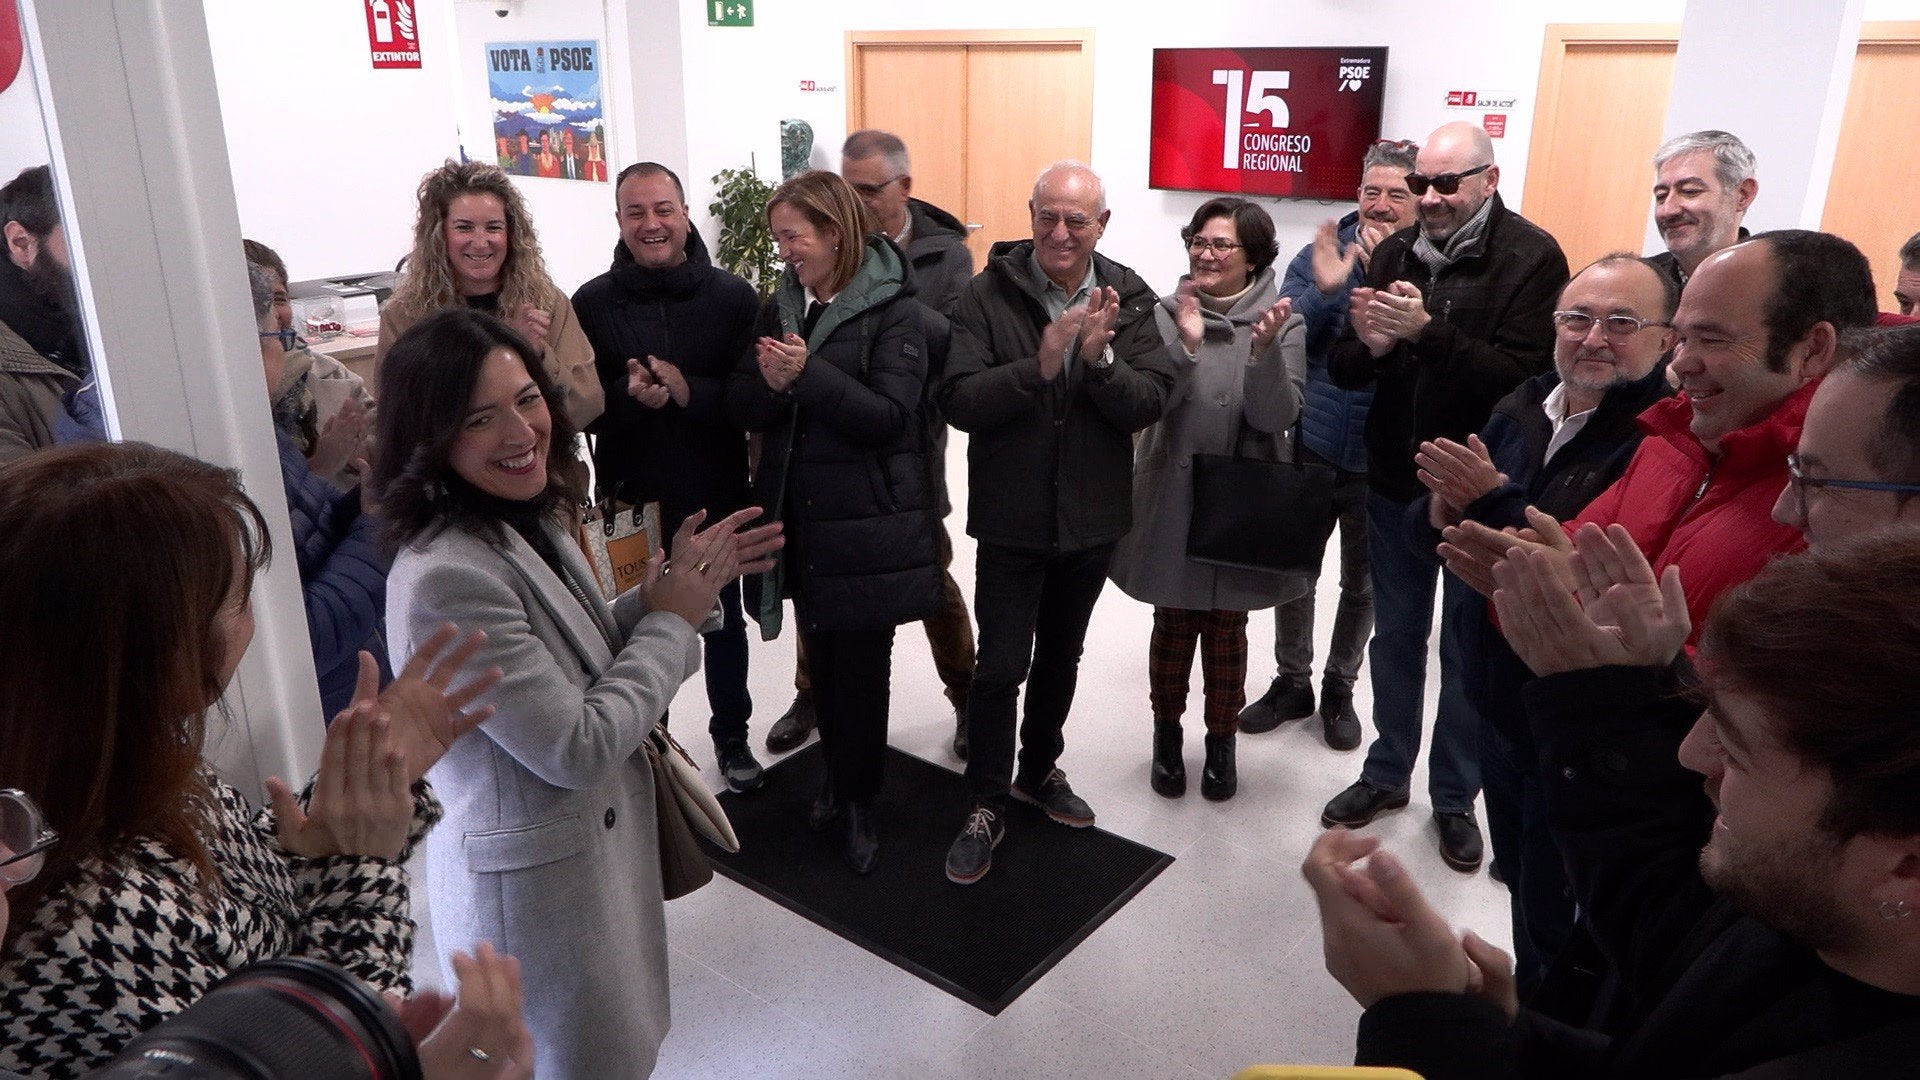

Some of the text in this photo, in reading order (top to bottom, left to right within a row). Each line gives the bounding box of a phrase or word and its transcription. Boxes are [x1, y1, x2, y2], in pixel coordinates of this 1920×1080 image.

[373, 51, 420, 62] EXTINTOR
[489, 47, 593, 72] VOTA PSOE
[1339, 66, 1371, 79] PSOE
[1212, 69, 1290, 169] 15
[1243, 133, 1311, 153] CONGRESO
[1243, 154, 1303, 172] REGIONAL
